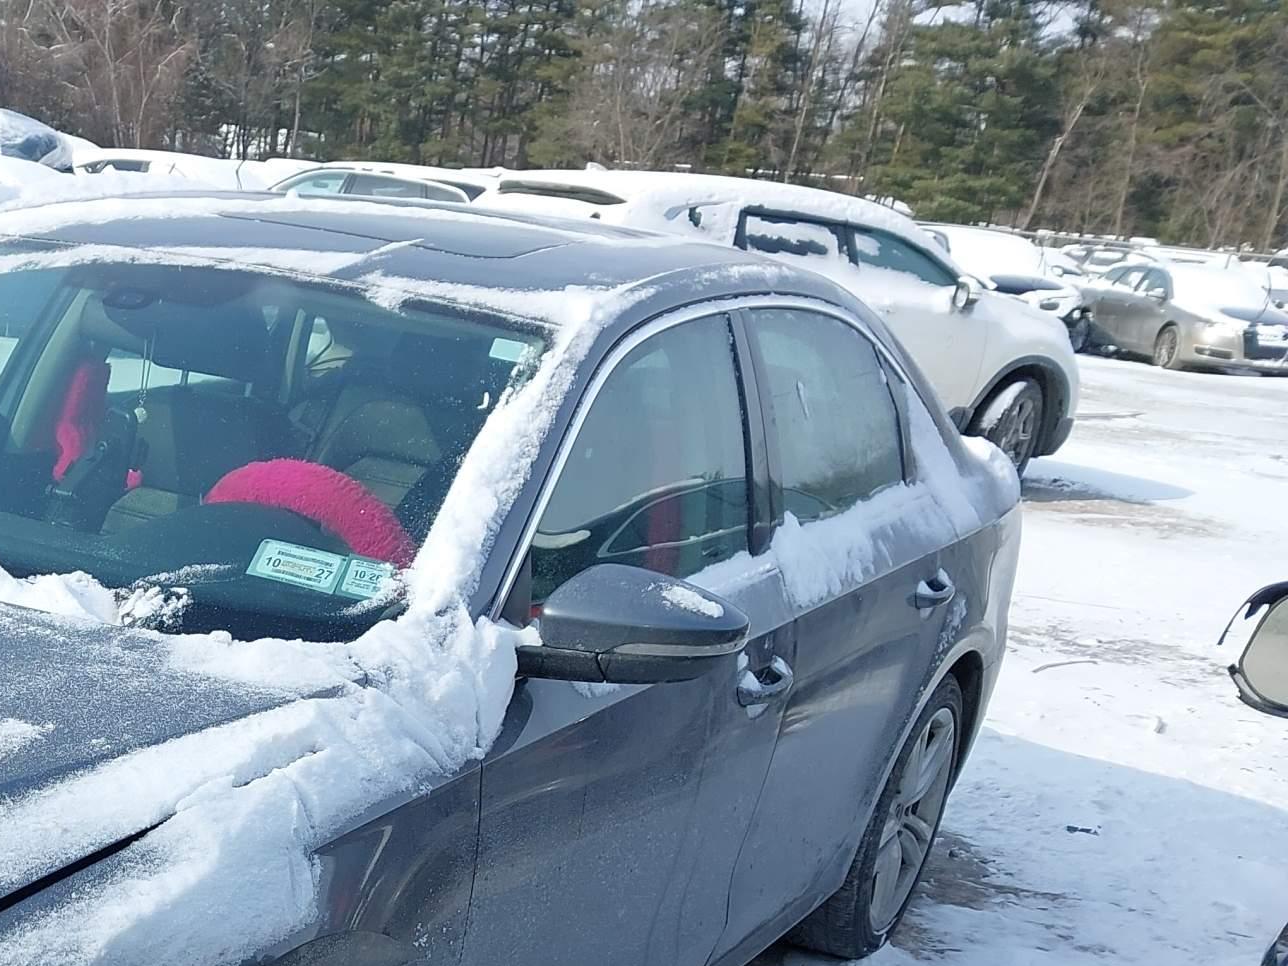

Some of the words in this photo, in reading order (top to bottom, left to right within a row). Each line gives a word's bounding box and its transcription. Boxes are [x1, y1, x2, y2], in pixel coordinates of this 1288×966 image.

[265, 556, 282, 568] 10
[314, 568, 334, 581] 27
[353, 569, 367, 579] 10
